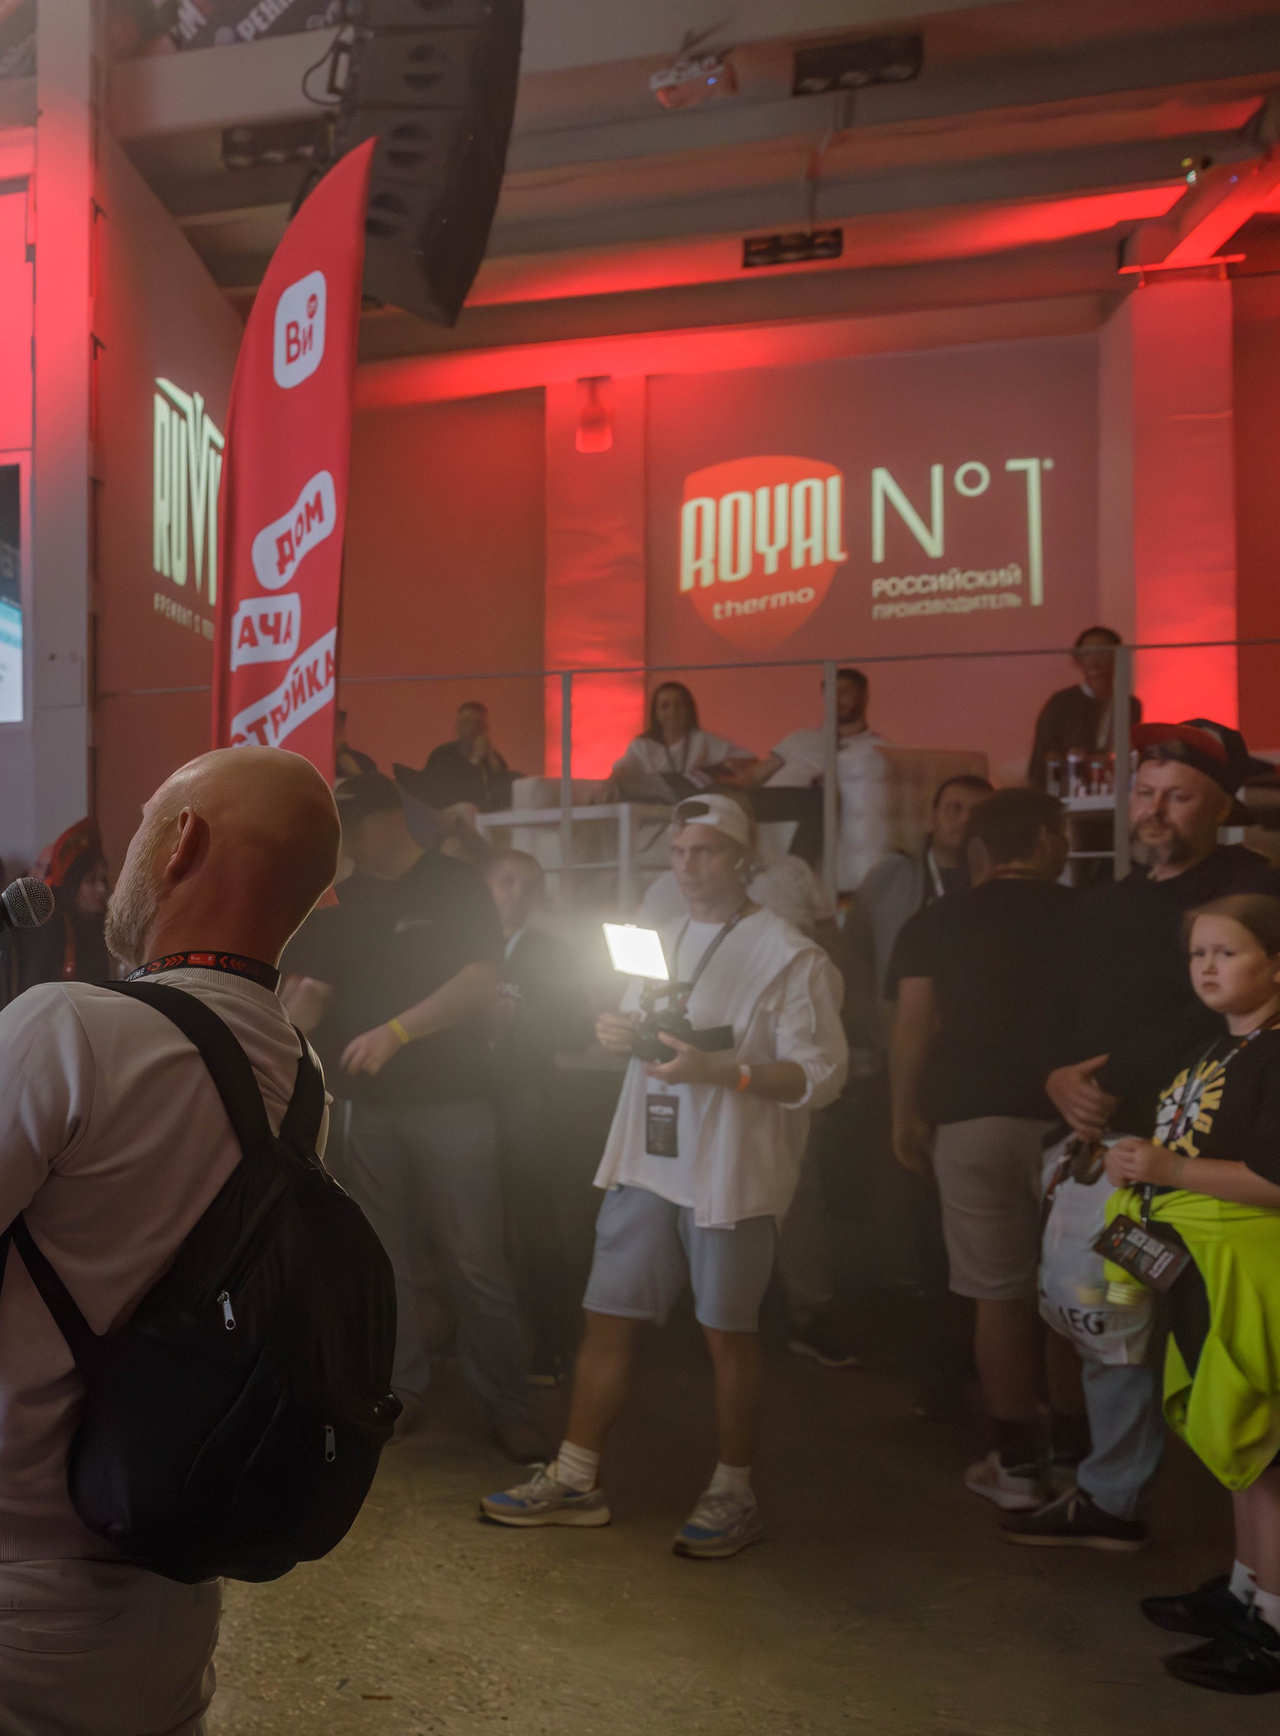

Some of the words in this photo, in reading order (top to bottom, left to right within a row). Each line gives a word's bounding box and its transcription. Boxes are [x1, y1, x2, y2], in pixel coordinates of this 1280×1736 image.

[275, 490, 324, 577] ДОМ
[679, 474, 848, 593] ROYAL
[713, 587, 815, 620] thermo
[871, 562, 1023, 599] РОССИЙСКИЙ
